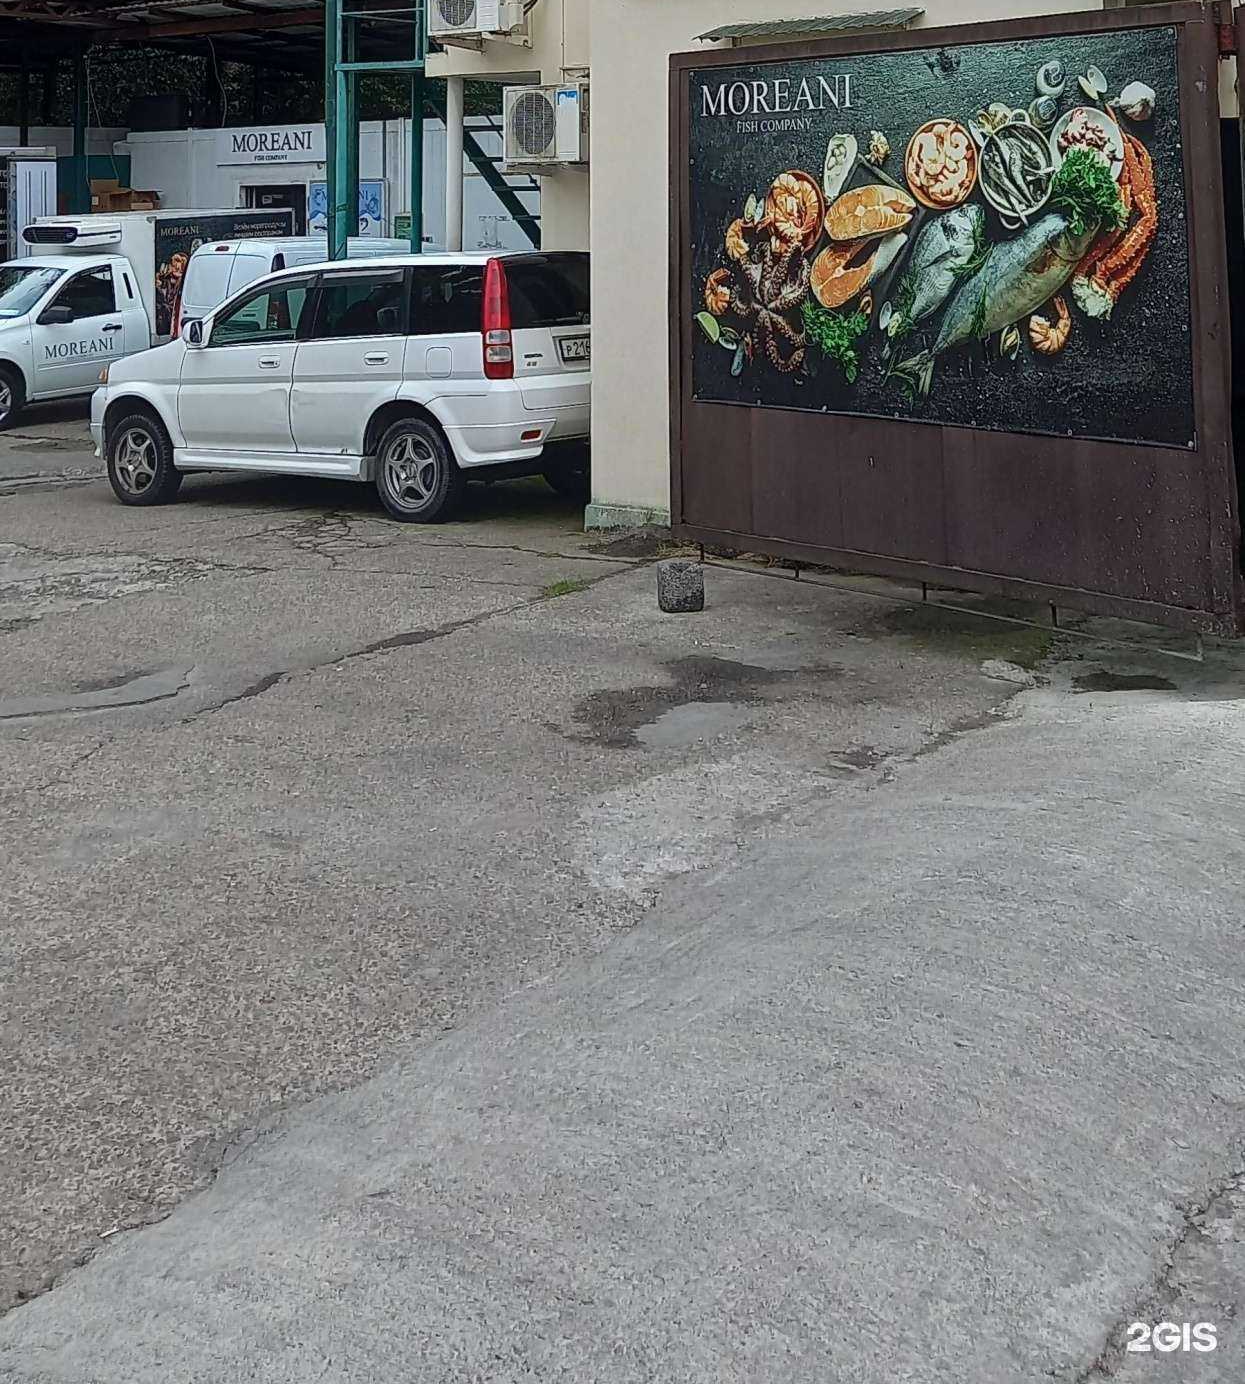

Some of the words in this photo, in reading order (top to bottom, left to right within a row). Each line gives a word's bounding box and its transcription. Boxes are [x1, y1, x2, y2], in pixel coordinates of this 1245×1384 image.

[700, 73, 854, 117] MOREANI
[736, 119, 758, 134] FISH
[760, 117, 813, 132] COMPANY
[231, 130, 313, 153] MOREANI
[160, 225, 200, 237] MOREANI
[45, 336, 114, 360] MOREANI
